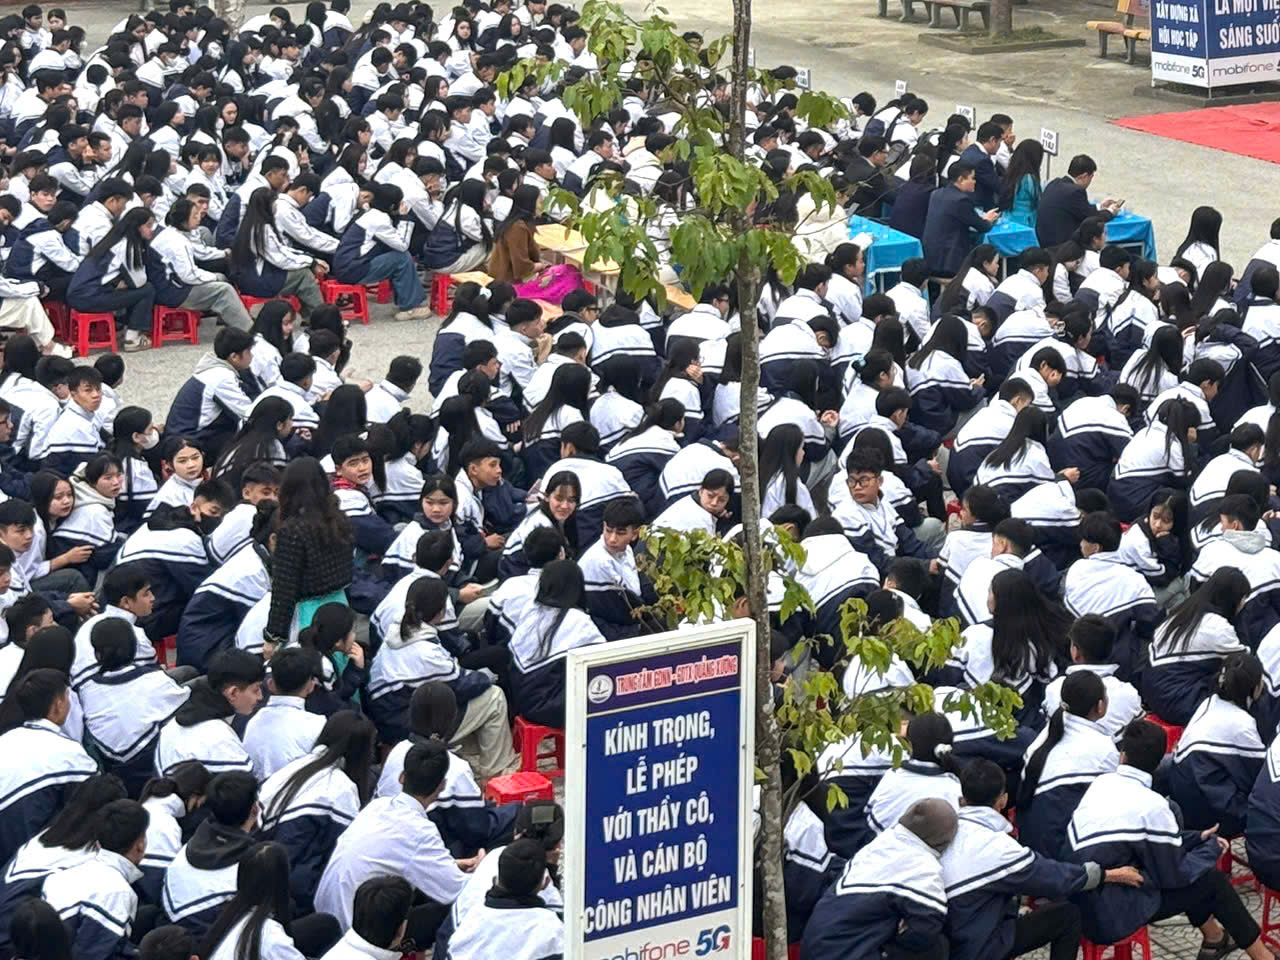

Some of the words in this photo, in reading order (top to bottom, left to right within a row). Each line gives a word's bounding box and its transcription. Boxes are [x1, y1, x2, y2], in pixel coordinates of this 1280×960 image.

[1219, 23, 1253, 50] SÁNG
[1154, 60, 1190, 75] mobifone
[1191, 65, 1205, 79] 5G
[1213, 60, 1274, 77] mobifone
[604, 721, 648, 756] KÍNH
[653, 710, 715, 747] TRỌNG,
[626, 755, 648, 795] LỄ
[652, 752, 698, 790] PHÉP
[603, 806, 633, 843] VỚI
[637, 794, 682, 836] THẦY
[686, 790, 714, 826] CÔ,
[614, 848, 638, 884] VÀ
[642, 842, 679, 878] CÁN
[683, 833, 708, 872] BỘ
[584, 899, 632, 934] CÔNG
[637, 889, 686, 924] NHÂN
[691, 875, 731, 910] VIÊN
[600, 939, 690, 960] bifone
[695, 924, 731, 956] 5G
